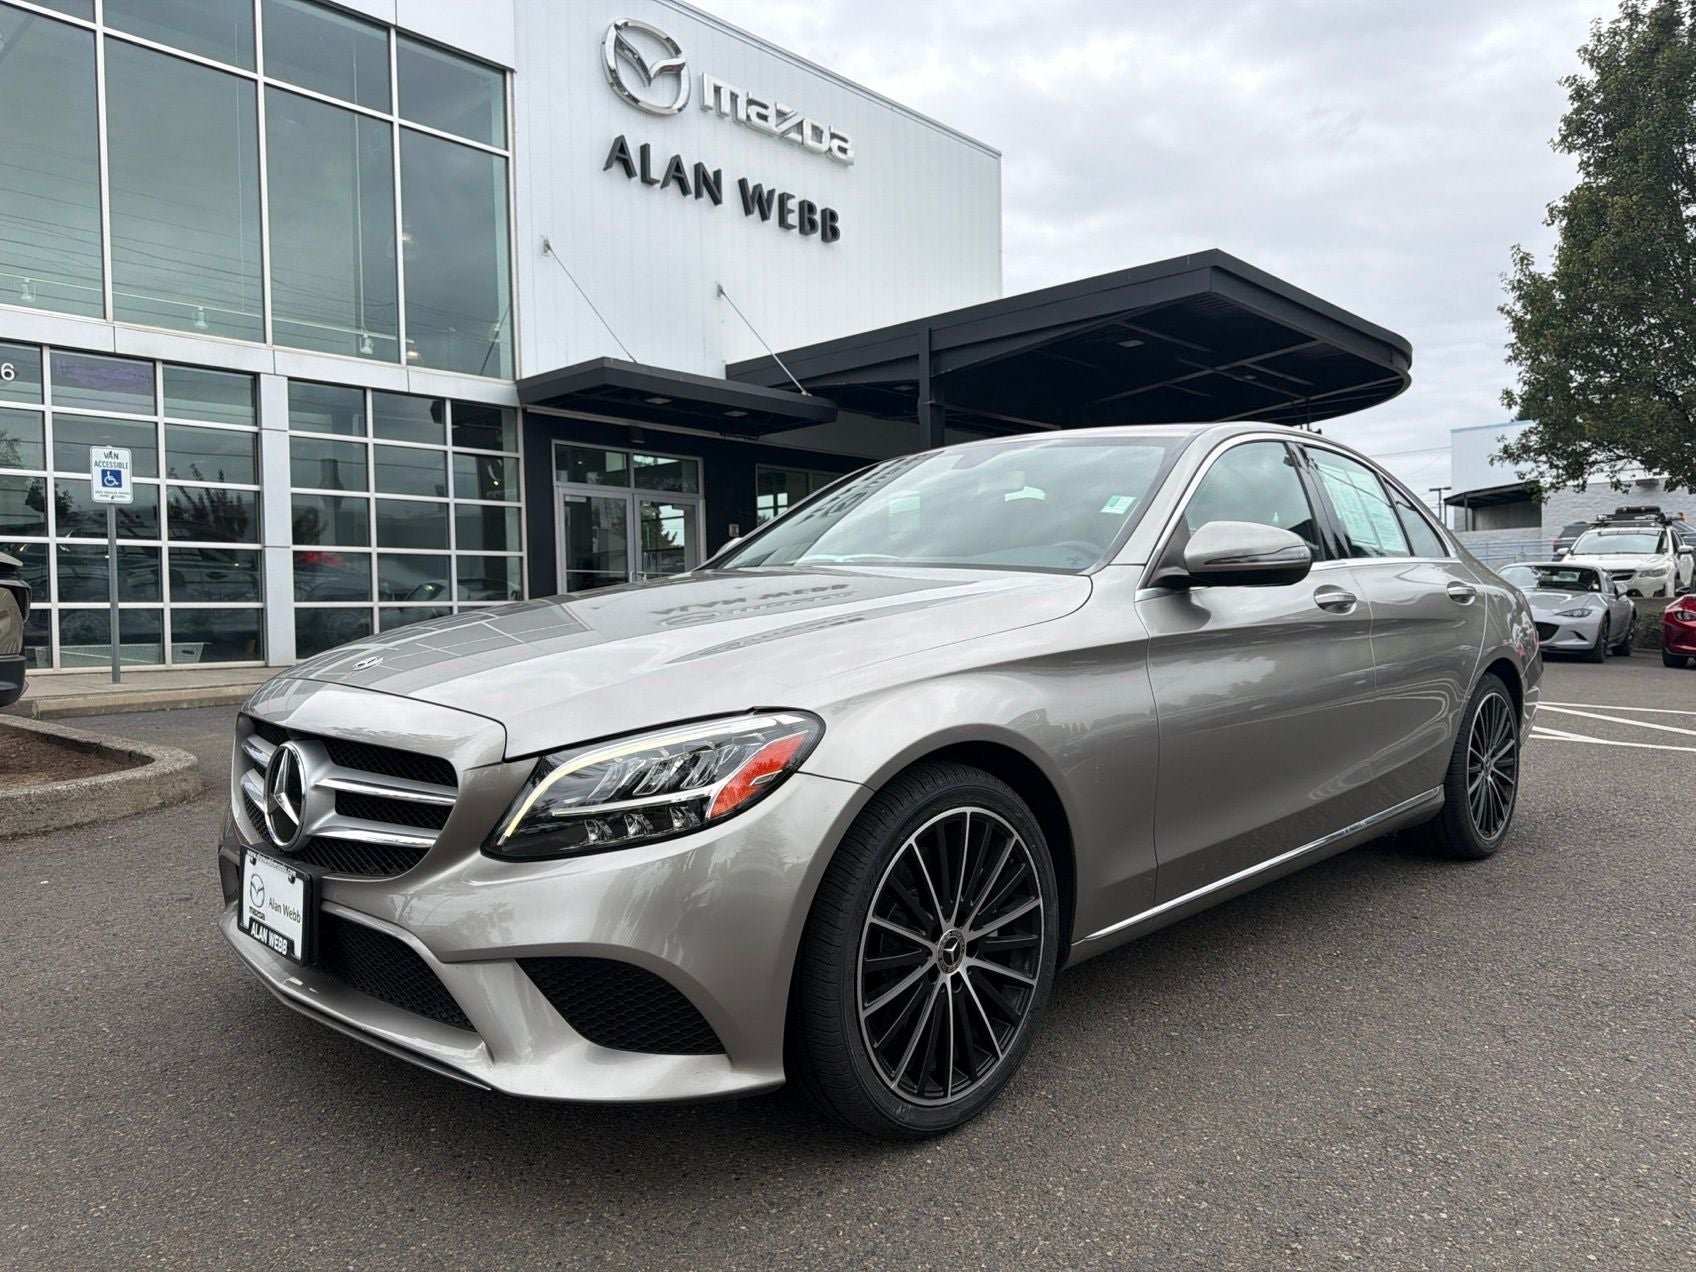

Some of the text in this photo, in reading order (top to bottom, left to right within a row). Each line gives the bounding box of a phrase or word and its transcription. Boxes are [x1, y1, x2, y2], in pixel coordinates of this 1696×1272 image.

[700, 72, 855, 166] mazda
[603, 134, 841, 243] ALAN WEBB
[94, 460, 129, 470] ACCESSIBLE
[103, 451, 119, 460] VAN
[268, 897, 301, 924] Alan Webb
[251, 921, 288, 955] ALAN WEBB
